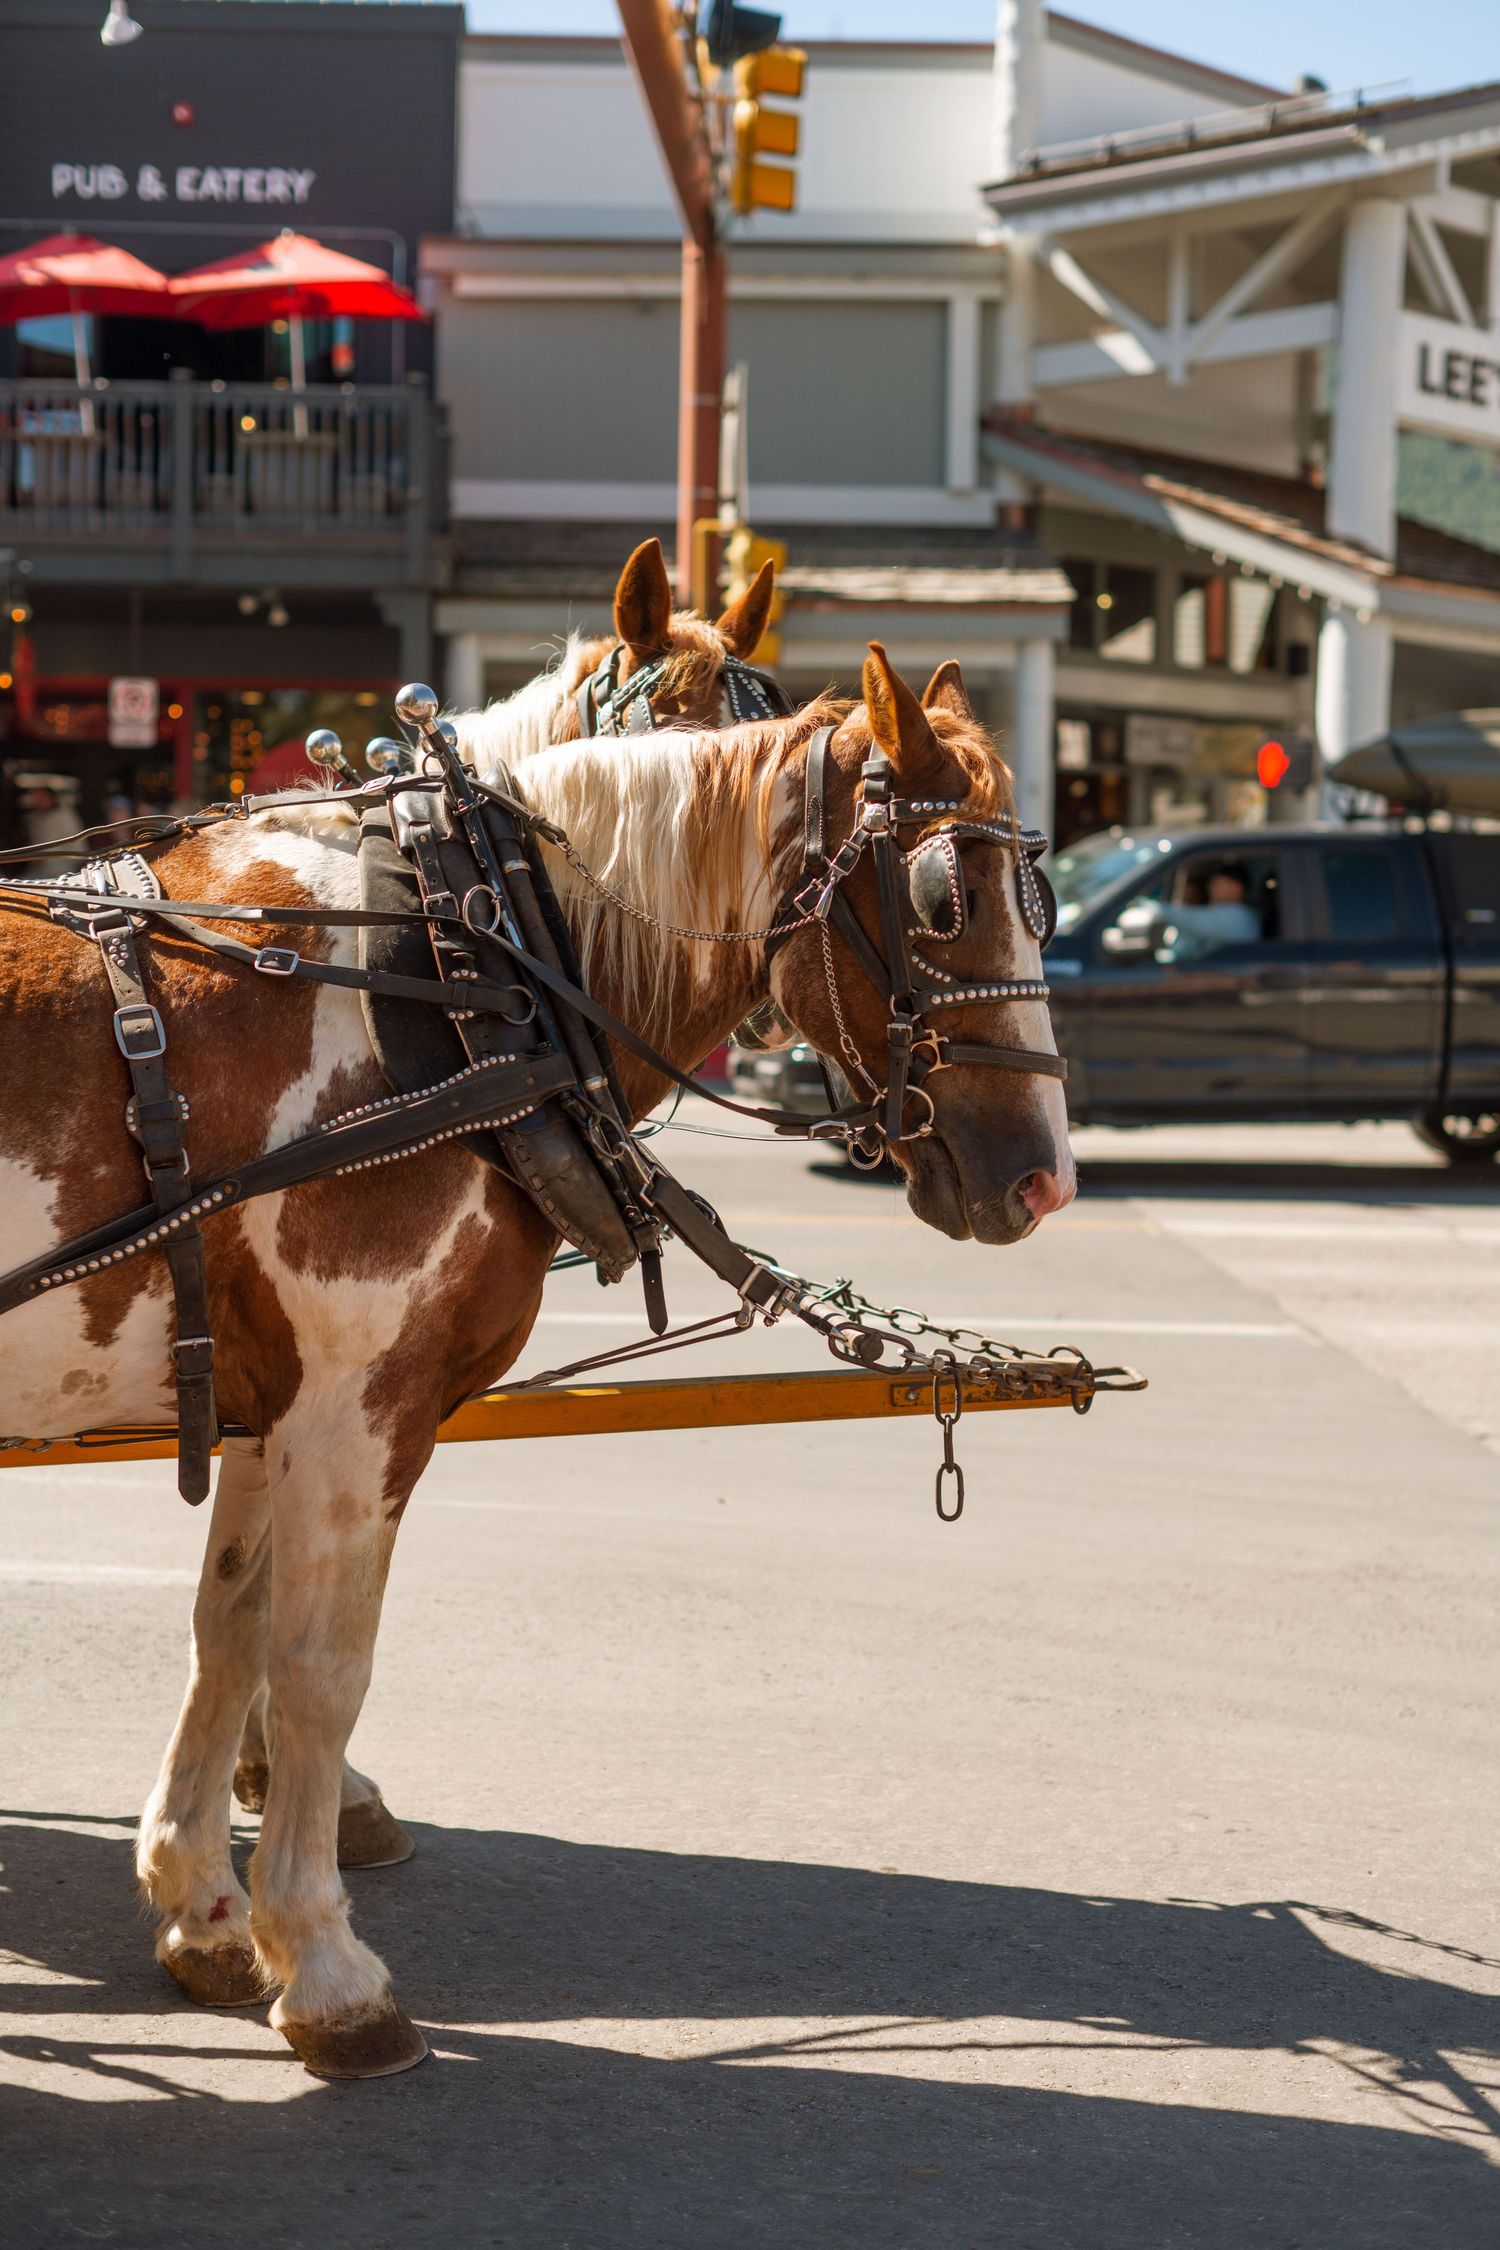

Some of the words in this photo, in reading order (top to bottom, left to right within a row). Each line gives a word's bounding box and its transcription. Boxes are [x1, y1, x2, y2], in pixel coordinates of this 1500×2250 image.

[52, 163, 127, 199] PUB
[137, 164, 167, 201] &
[175, 166, 316, 203] EATERY
[1418, 342, 1500, 408] LEE
